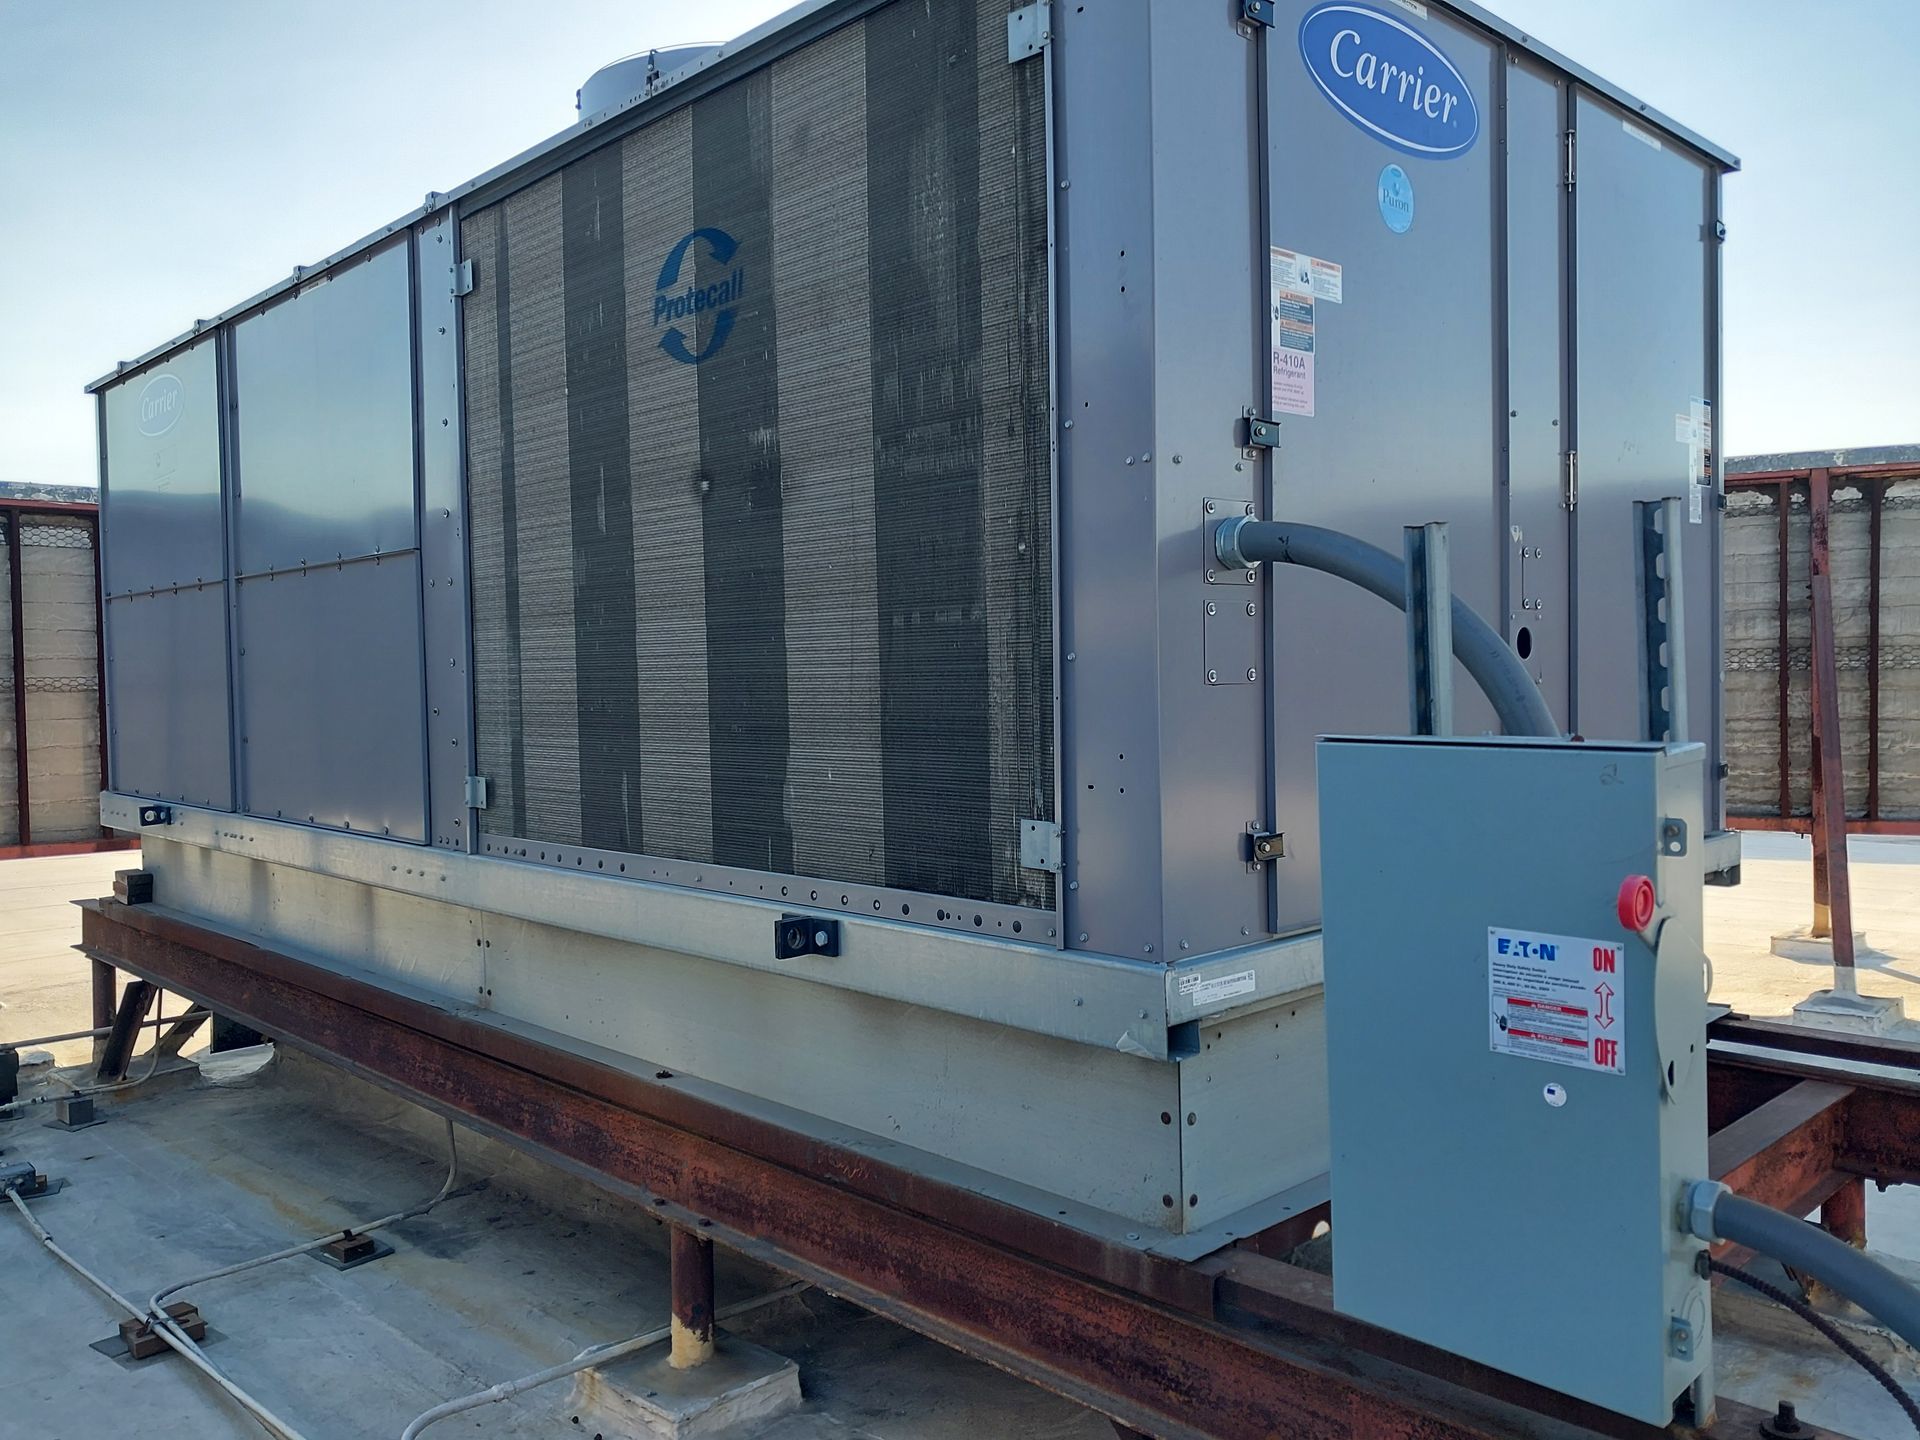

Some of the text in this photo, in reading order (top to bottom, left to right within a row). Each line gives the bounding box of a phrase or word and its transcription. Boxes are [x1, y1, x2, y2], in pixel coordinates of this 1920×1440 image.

[1330, 29, 1458, 124] Carrier
[1382, 188, 1409, 213] Puron
[653, 267, 744, 327] Protecall
[1273, 351, 1306, 370] R-410A
[1273, 365, 1306, 380] Refrigerant
[141, 388, 179, 422] Carrier
[1498, 937, 1556, 961] EATON
[1593, 947, 1616, 974] ON
[1594, 1037, 1618, 1068] OFF
